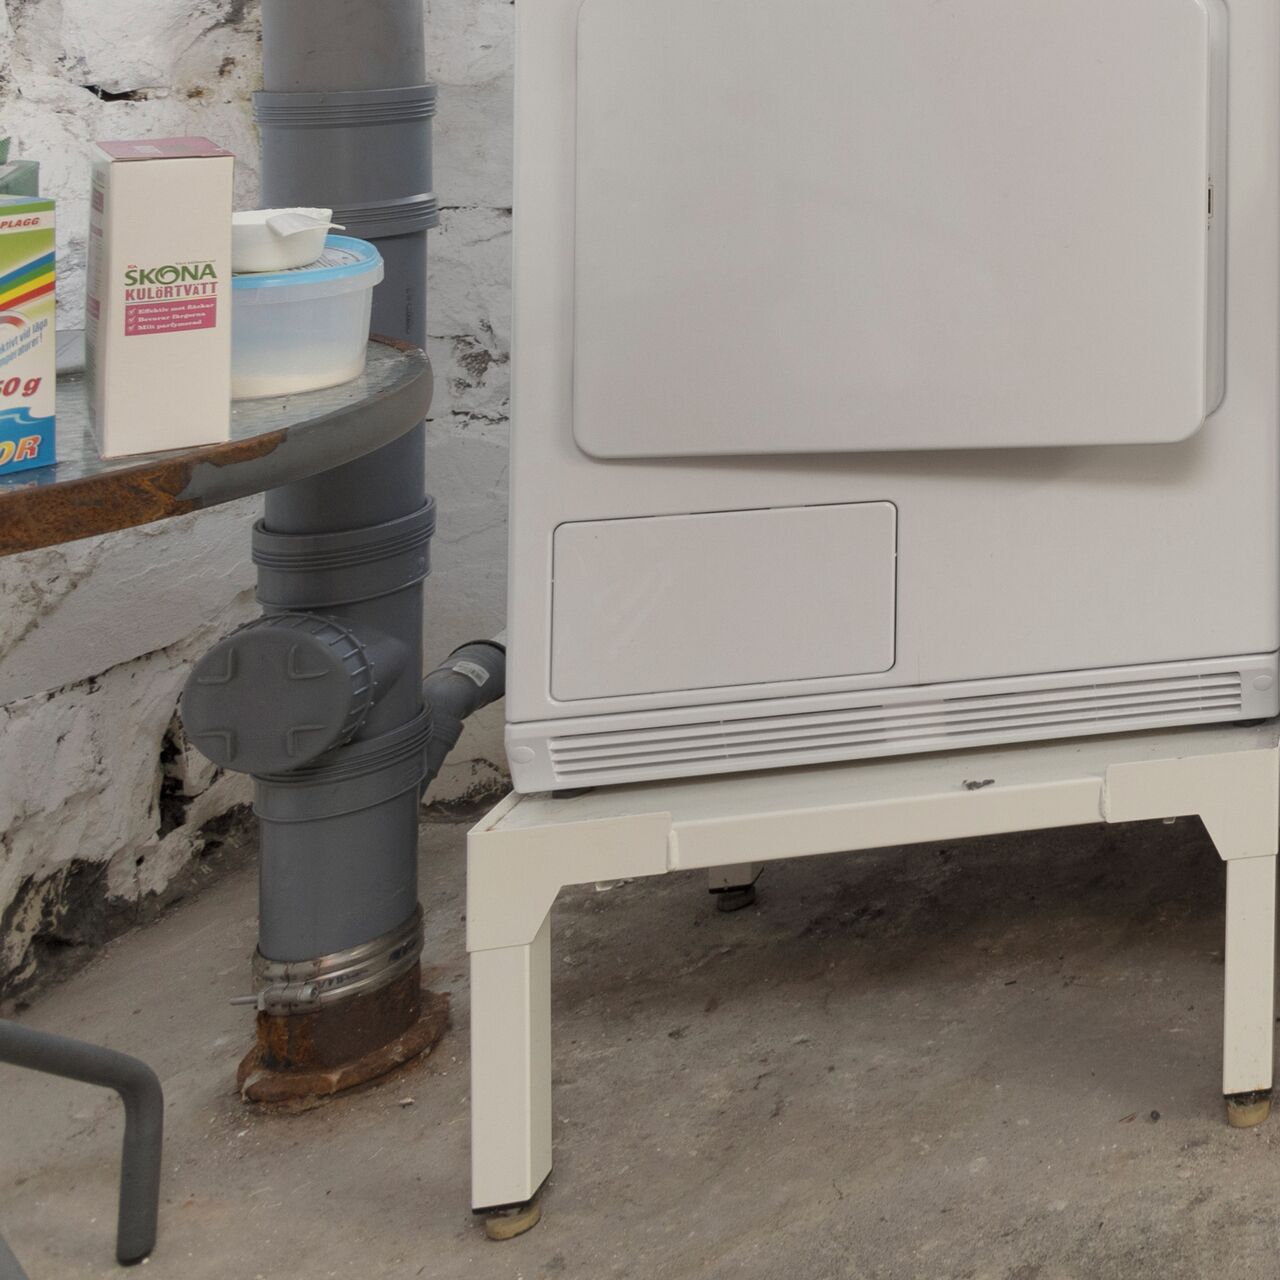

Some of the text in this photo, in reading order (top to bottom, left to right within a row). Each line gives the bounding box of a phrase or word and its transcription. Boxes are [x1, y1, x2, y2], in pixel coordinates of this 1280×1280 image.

[124, 263, 218, 287] SKONA
[125, 281, 218, 302] KULÖRTVÄTT
[0, 377, 42, 397] 0 g
